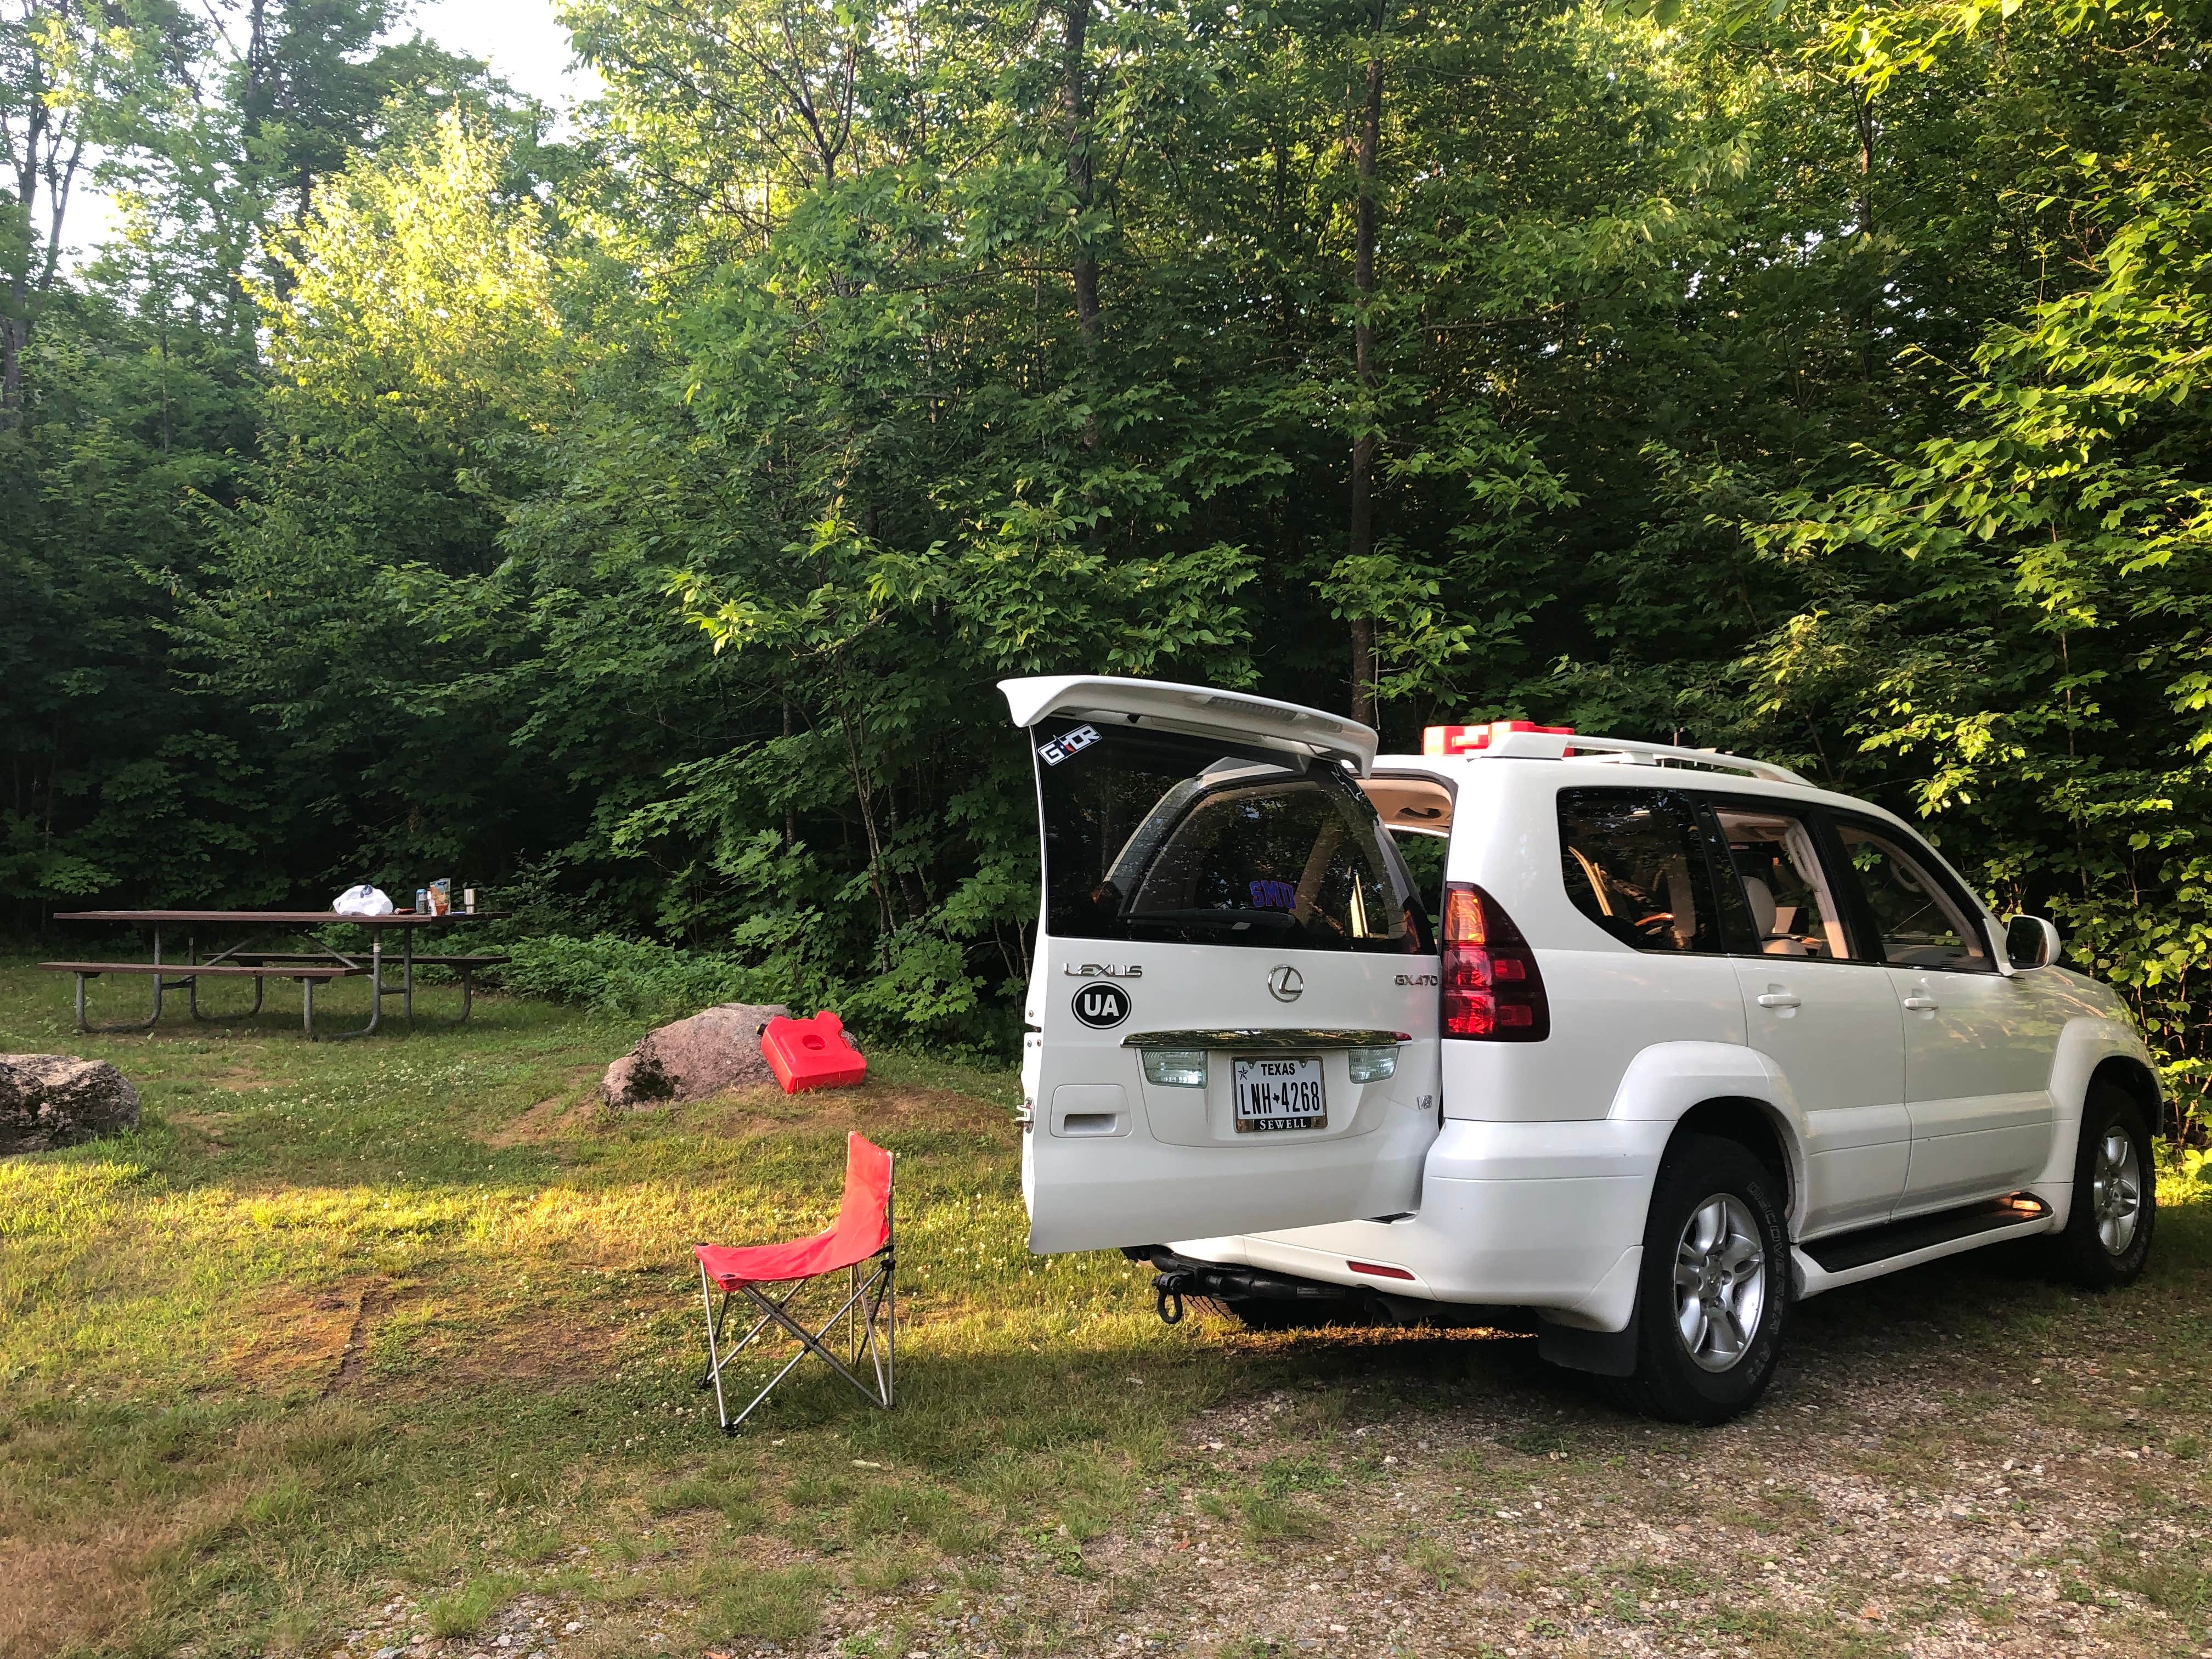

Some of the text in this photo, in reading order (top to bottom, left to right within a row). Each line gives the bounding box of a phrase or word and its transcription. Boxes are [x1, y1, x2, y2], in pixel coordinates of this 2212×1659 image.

[1249, 880, 1296, 909] SMU
[1064, 962, 1142, 978] LEXUS
[1085, 994, 1119, 1016] UA
[1261, 1063, 1295, 1076] TEXAS
[1417, 1095, 1432, 1110] V8
[1260, 1119, 1306, 1130] SEWELL
[1747, 1182, 1785, 1335] DISCOVERER
